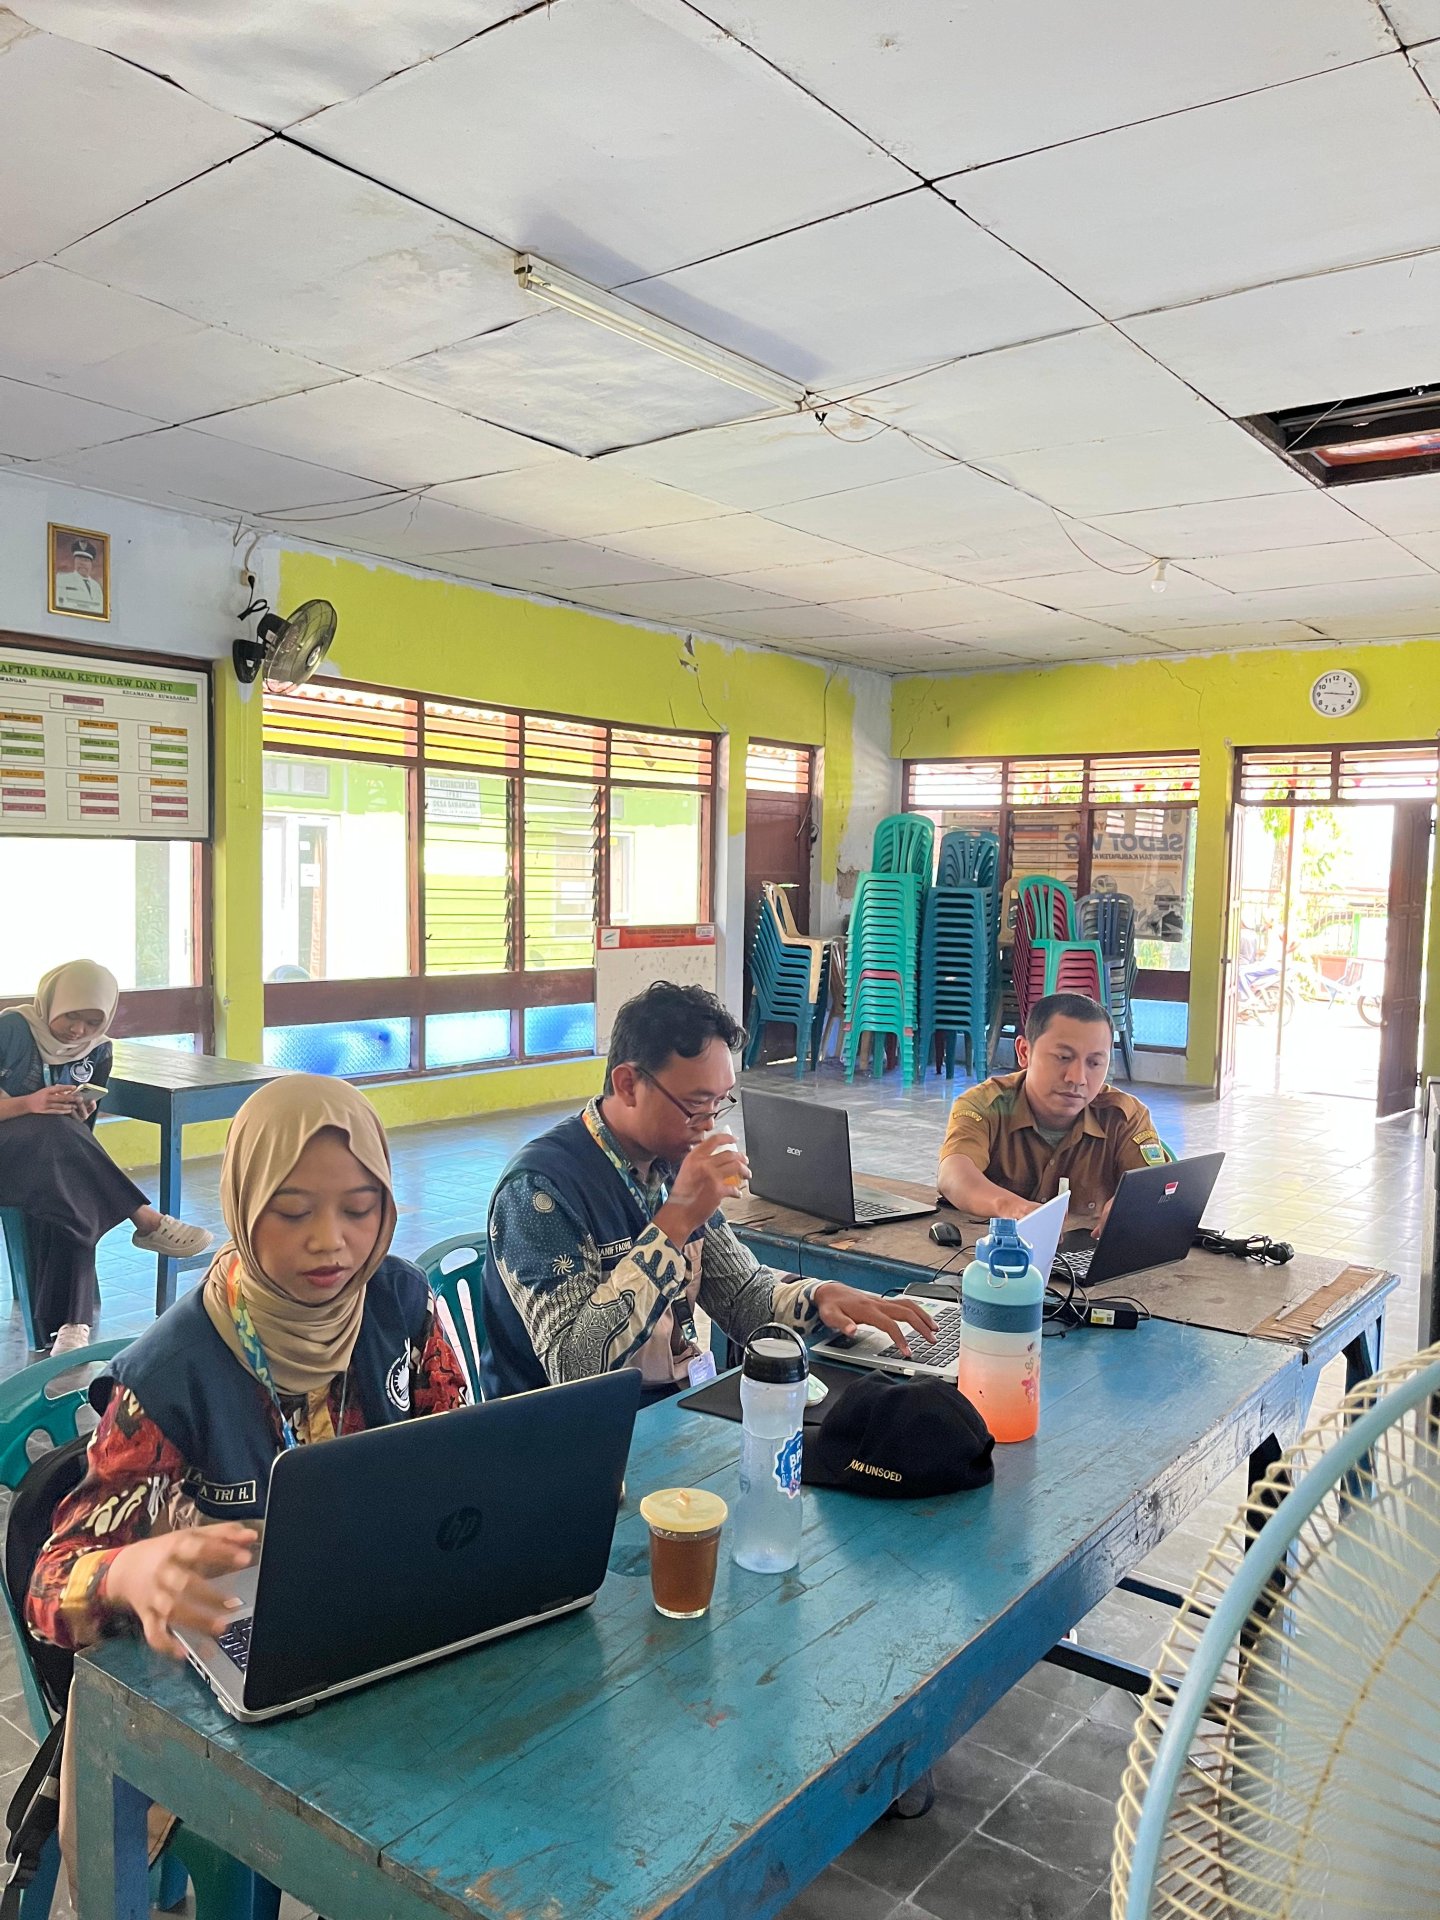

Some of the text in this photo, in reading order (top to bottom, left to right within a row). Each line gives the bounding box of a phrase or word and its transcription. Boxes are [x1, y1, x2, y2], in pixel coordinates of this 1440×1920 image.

[0, 664, 173, 691] AFTAR NAMA KETUA RW DAN RT
[865, 1464, 902, 1482] UNSOED
[214, 1488, 234, 1501] TRI
[239, 1486, 249, 1500] H.
